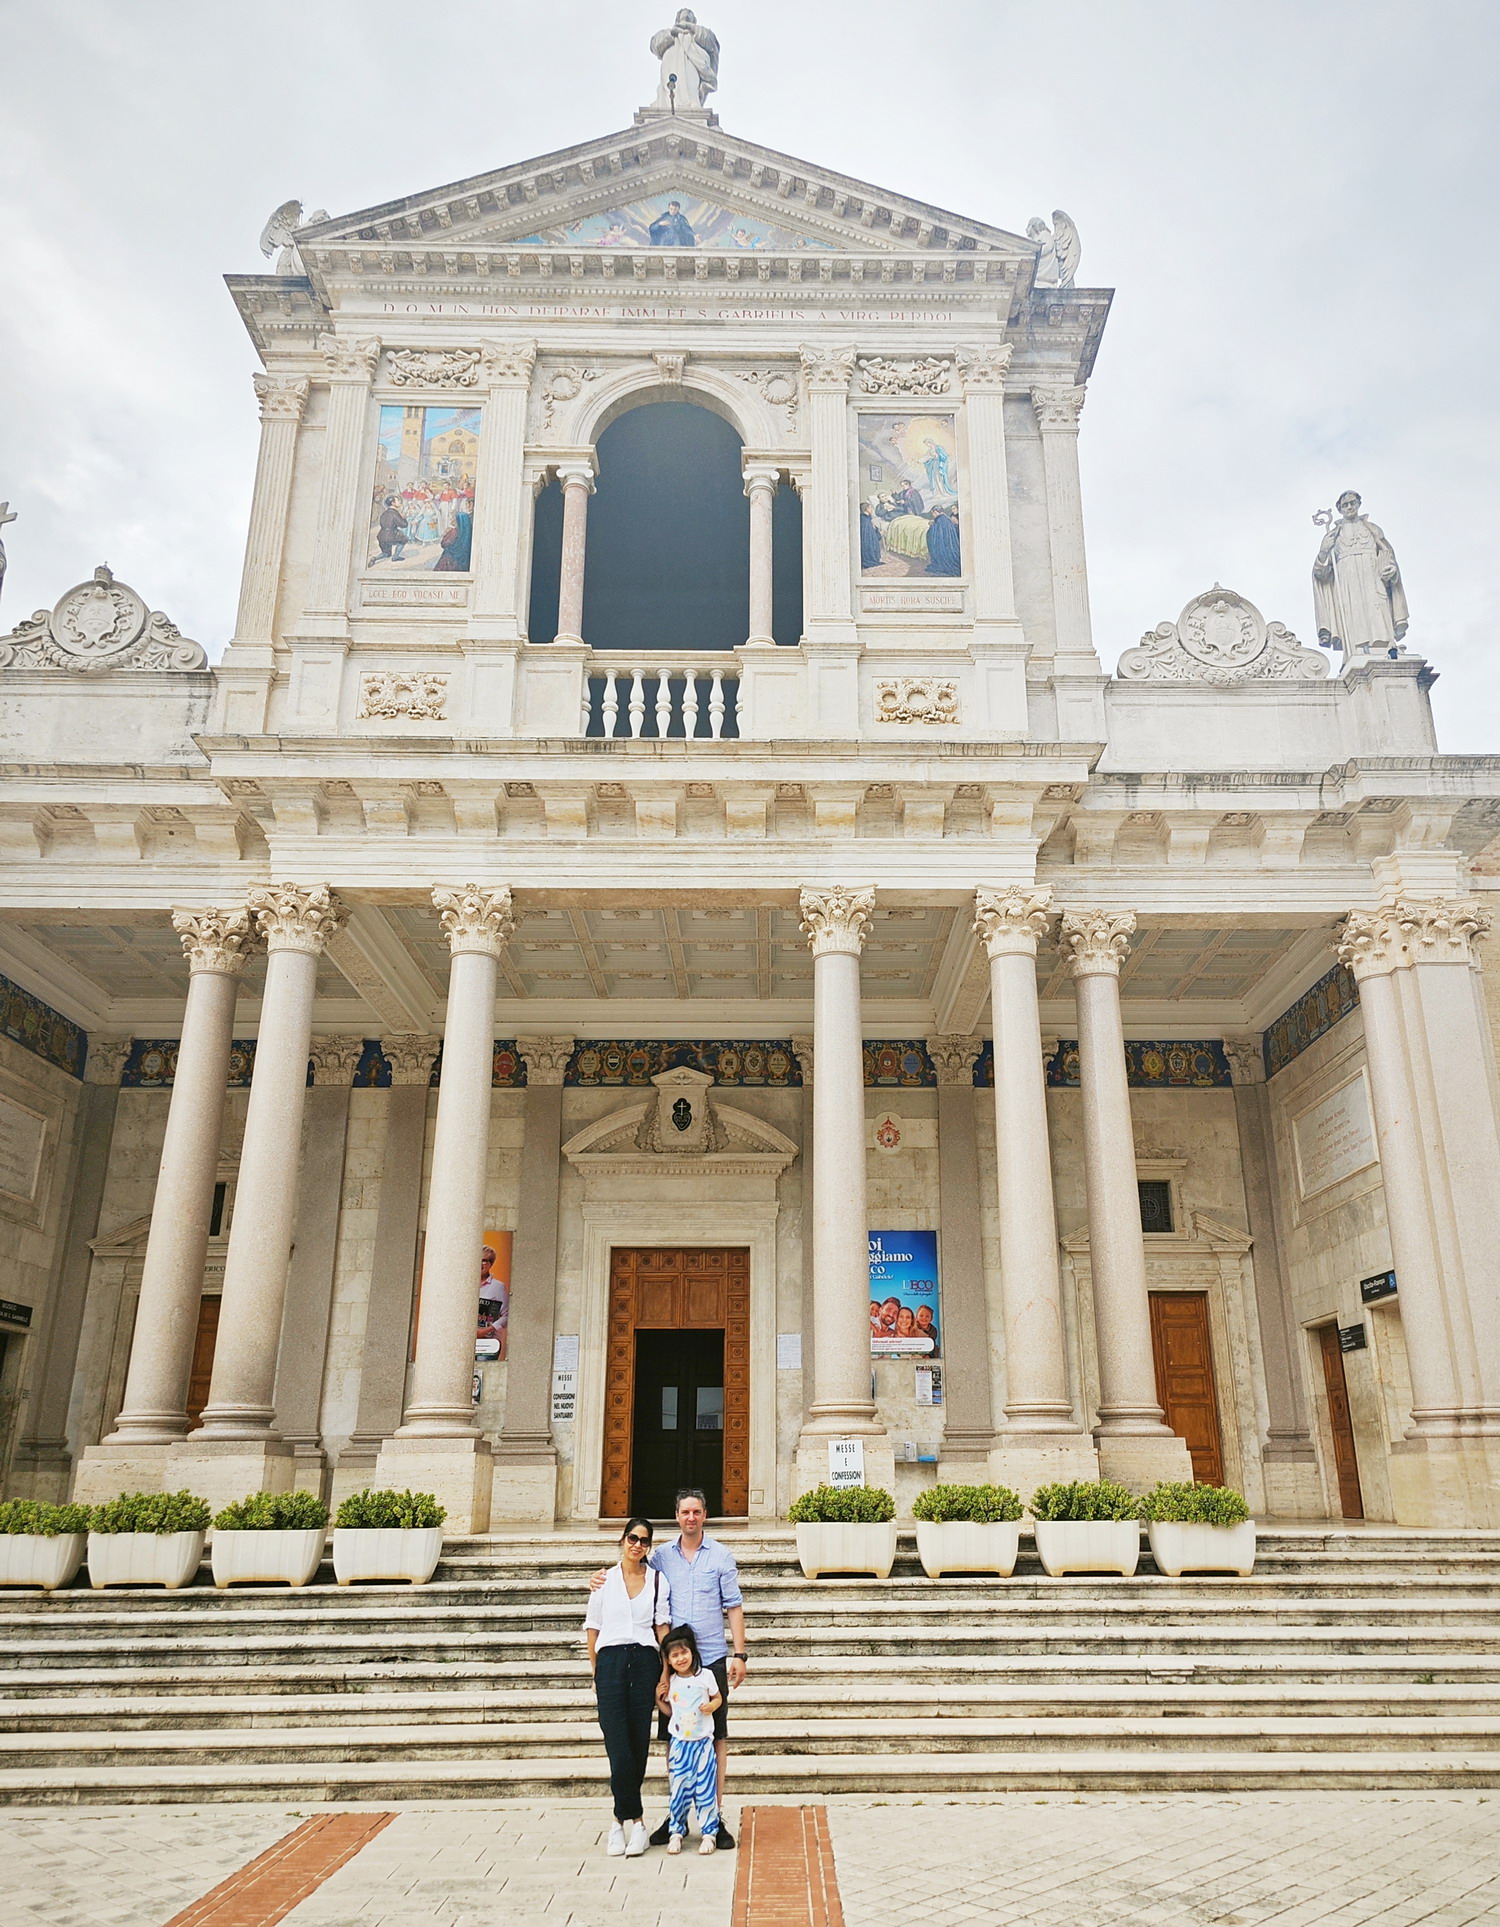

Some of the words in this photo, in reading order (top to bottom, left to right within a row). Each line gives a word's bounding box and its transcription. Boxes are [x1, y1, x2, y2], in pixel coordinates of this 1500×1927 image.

[667, 308, 687, 318] ET
[869, 1265, 885, 1274] co
[836, 1444, 855, 1453] MESSE
